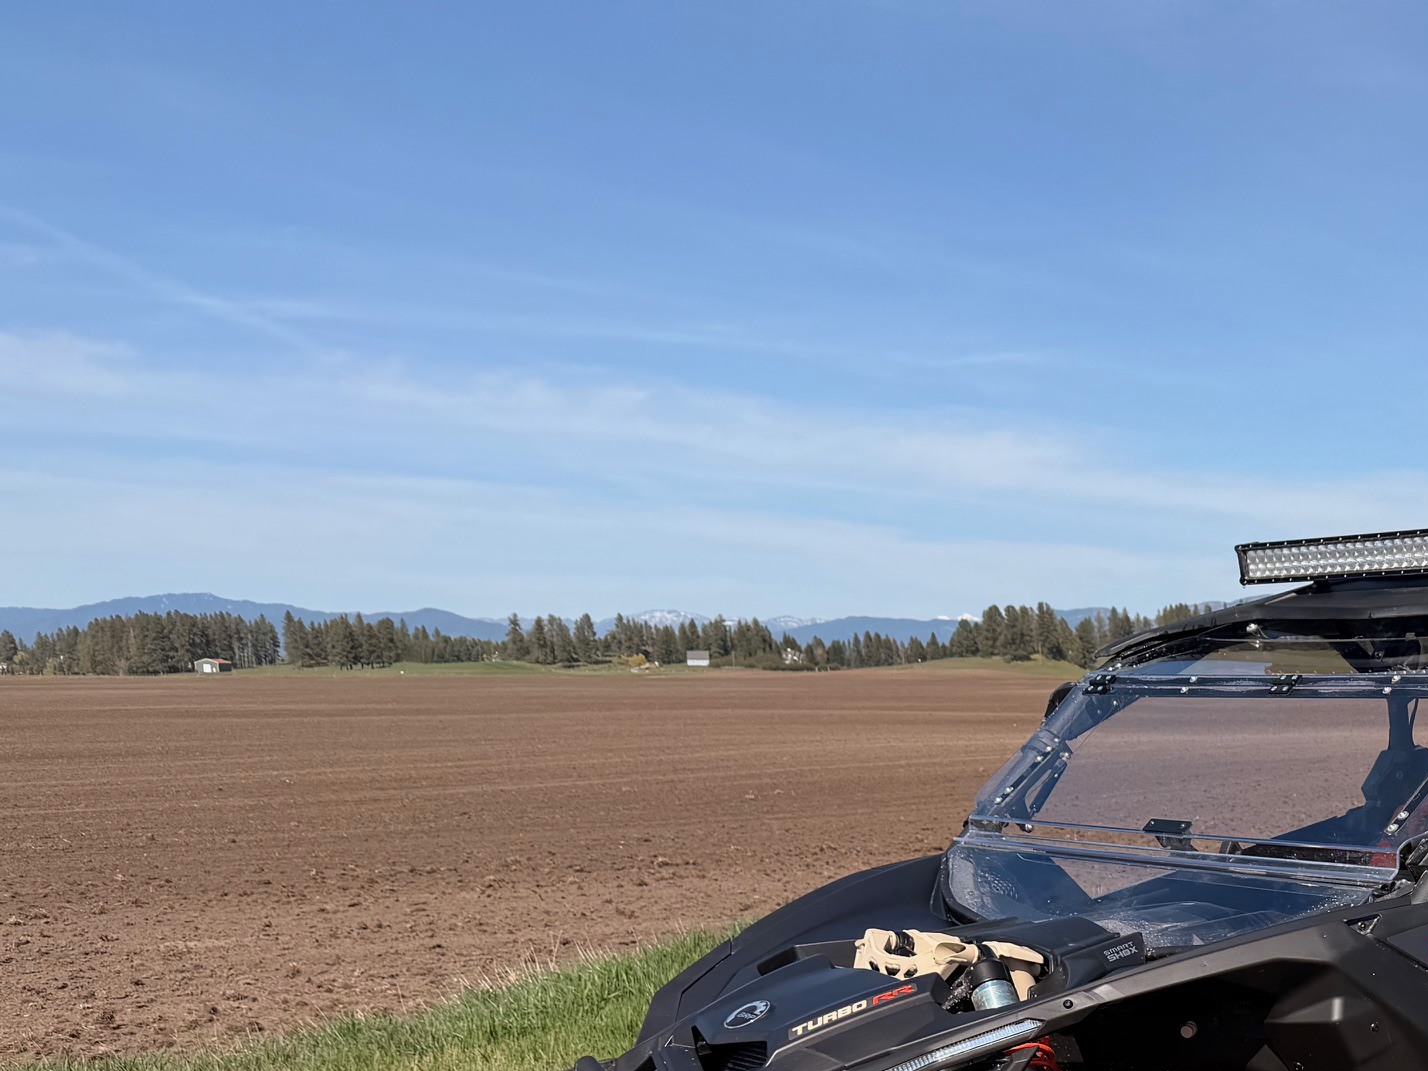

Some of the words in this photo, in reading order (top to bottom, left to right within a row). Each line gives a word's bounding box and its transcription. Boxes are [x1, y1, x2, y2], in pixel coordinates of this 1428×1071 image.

[1103, 941, 1134, 956] SMART
[792, 999, 868, 1036] TURBO
[872, 985, 915, 1006] RR
